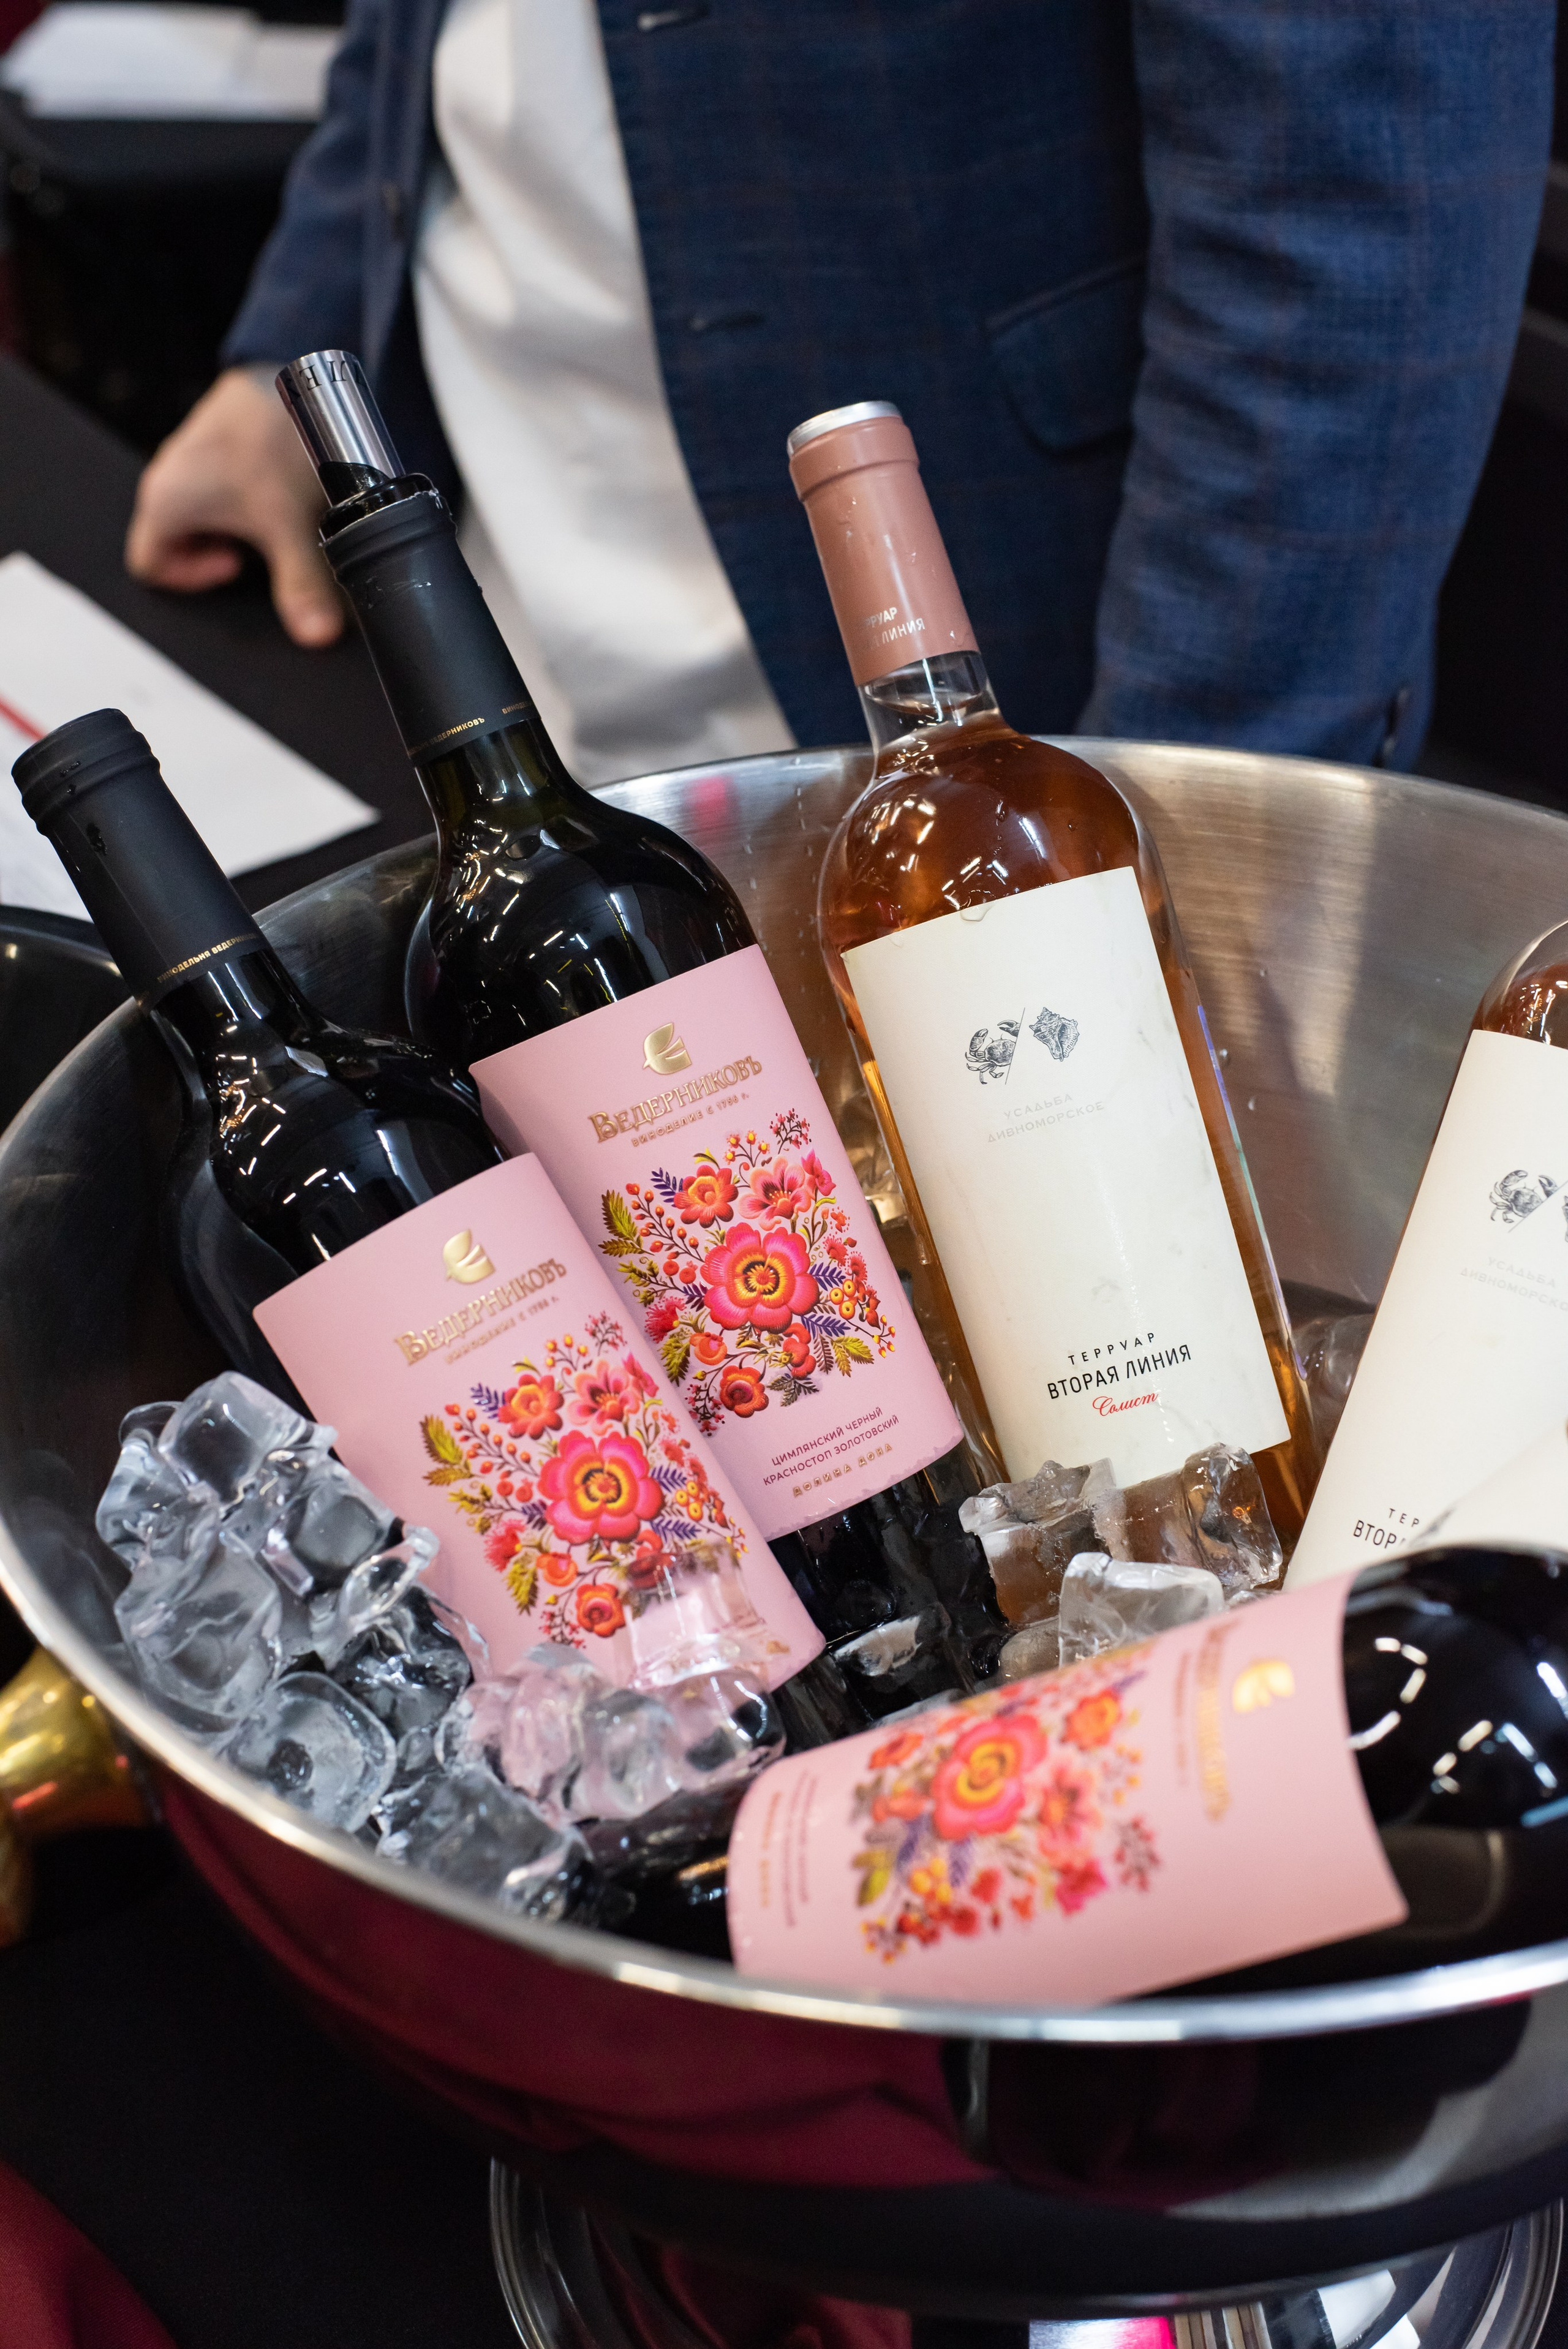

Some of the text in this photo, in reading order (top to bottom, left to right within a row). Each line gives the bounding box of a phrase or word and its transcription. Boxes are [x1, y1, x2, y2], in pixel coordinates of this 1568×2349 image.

[881, 617, 926, 643] ЛИНИЯ
[430, 717, 485, 744] ВЕДЕРНИКОВЪ
[587, 1055, 763, 1144] ВЕДЕРНИКОВЪ
[1003, 1093, 1073, 1120] УСАДЬБА
[631, 1110, 703, 1147] ВИНОДЕЛИЕ
[987, 1101, 1105, 1144] ДИВНОМОРСКОЕ
[1488, 1256, 1556, 1289] УСАДЬБА
[393, 1257, 568, 1367] ВЕДЕРНИКОВЪ
[1068, 1332, 1155, 1365] ТЕРРУАР
[1047, 1344, 1192, 1400] ВТОРАЯ ЛИНИЯ
[1092, 1391, 1159, 1417] Солист
[763, 1414, 900, 1486] КРАСНОСТОП ЗОЛОТОВСКИЙ
[771, 1406, 883, 1466] ЦИМЛЯНСКИЙ ЧЕРНЫЙ
[793, 1443, 893, 1498] ДОЛИНА ДОНА
[1389, 1507, 1420, 1528] ТЕР
